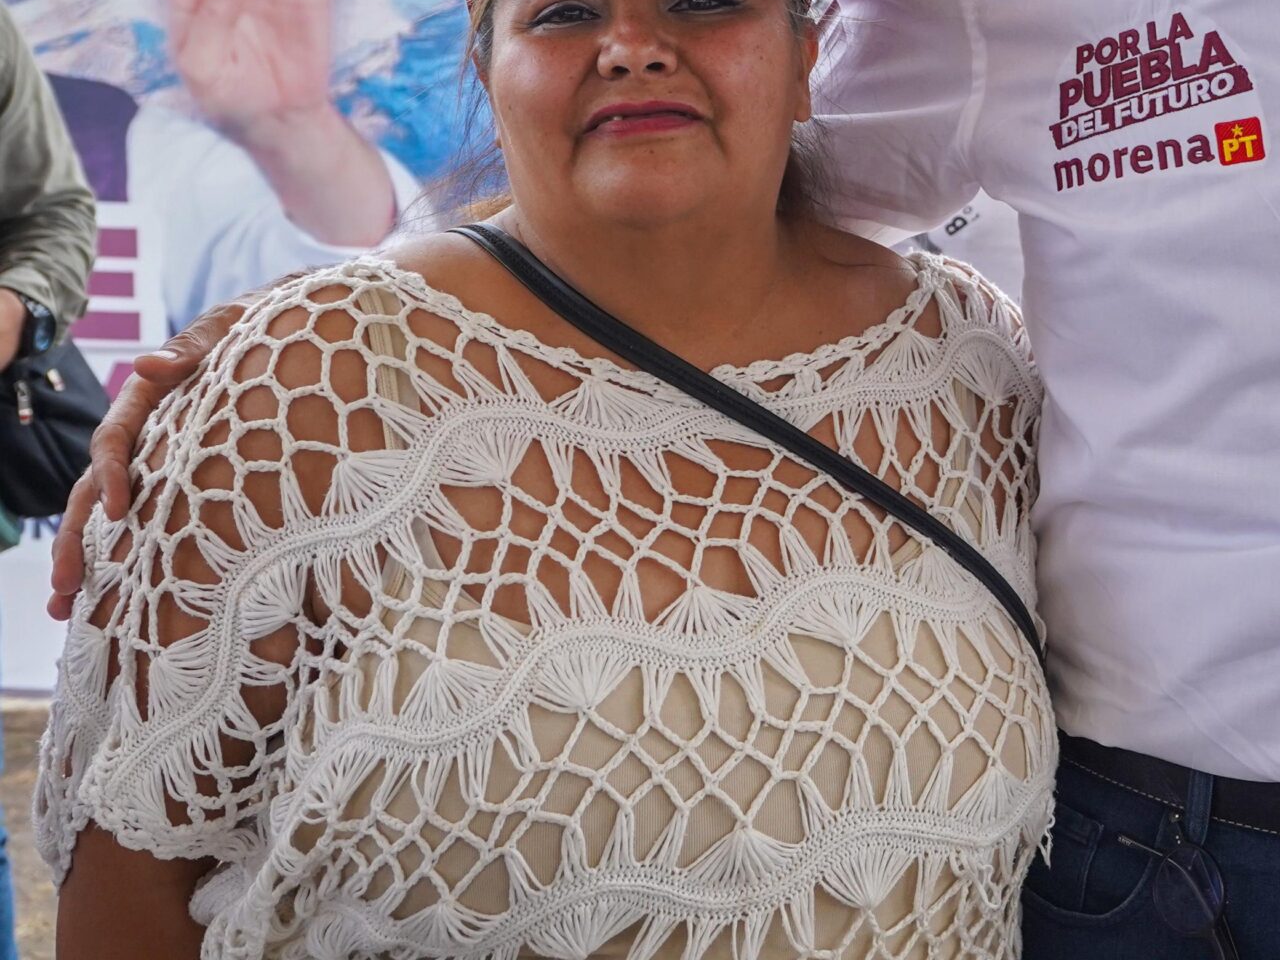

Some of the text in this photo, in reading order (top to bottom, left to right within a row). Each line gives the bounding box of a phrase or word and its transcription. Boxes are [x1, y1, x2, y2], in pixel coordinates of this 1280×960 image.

[1076, 12, 1194, 74] POR LA
[1059, 30, 1236, 120] PUEBLA
[1060, 72, 1235, 145] DEL FUTURO
[1054, 134, 1215, 191] morena
[1222, 134, 1257, 161] PT
